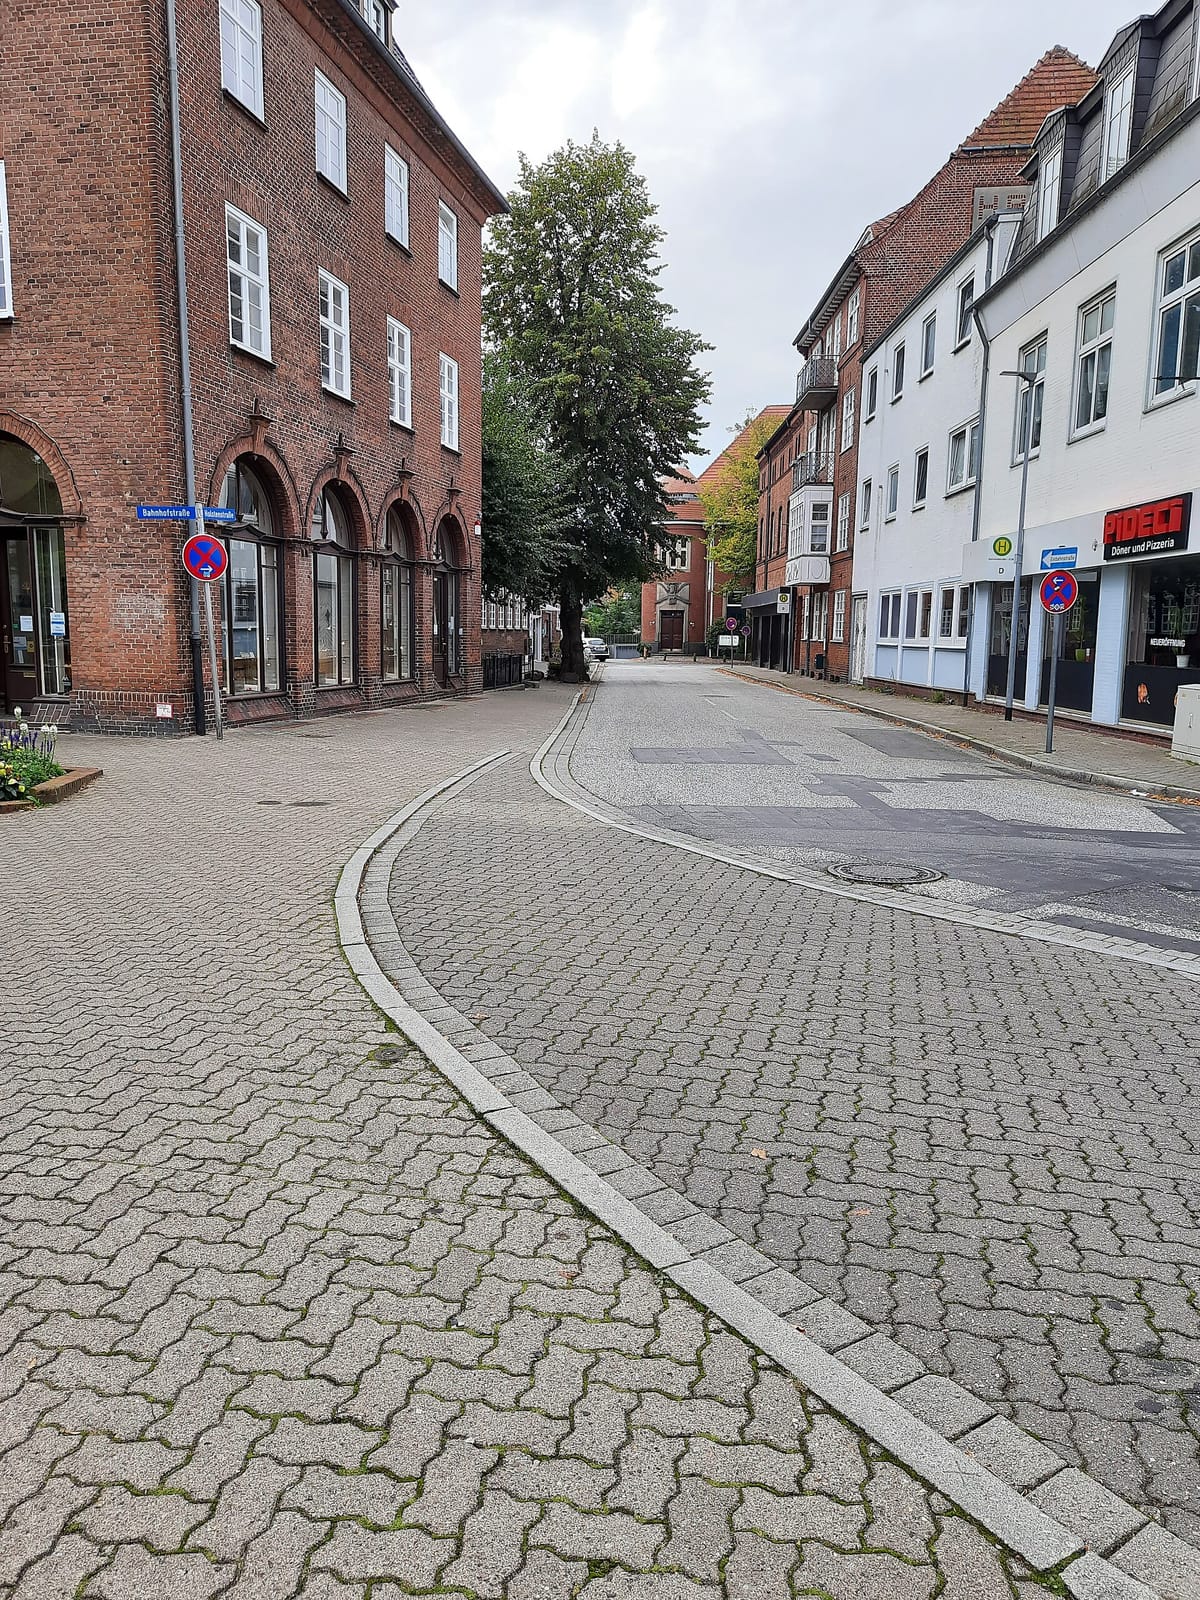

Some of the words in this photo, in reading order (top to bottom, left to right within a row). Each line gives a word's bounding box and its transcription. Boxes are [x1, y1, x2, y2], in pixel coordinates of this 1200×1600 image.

[142, 508, 191, 518] Bahnhofstraße
[998, 540, 1007, 553] H
[1111, 545, 1132, 556] Döner
[1132, 539, 1146, 553] und
[1146, 537, 1175, 551] Pizzeria
[998, 567, 1005, 575] D
